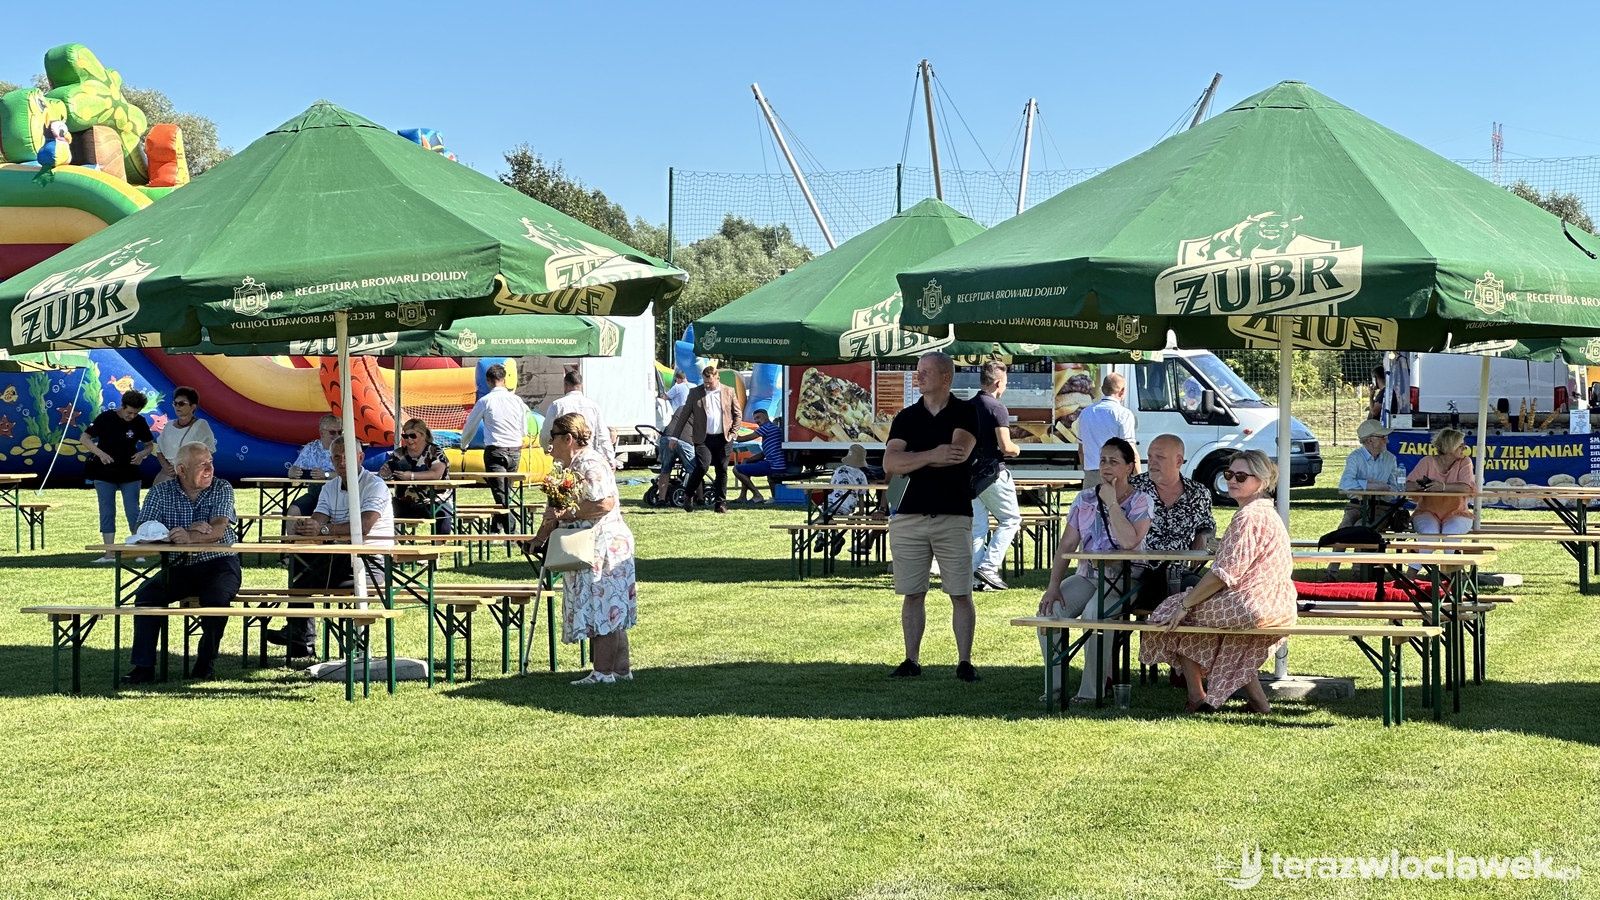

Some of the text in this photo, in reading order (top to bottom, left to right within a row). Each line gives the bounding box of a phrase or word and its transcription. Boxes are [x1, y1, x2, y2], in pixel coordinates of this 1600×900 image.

[270, 290, 284, 301] 68
[294, 281, 359, 298] RECEPTURA
[361, 273, 419, 289] BROWARU
[421, 270, 469, 283] DOJLIDY
[943, 294, 951, 304] 68
[957, 291, 995, 304] RECEPTURA
[995, 287, 1034, 300] BROWARU
[1034, 285, 1069, 298] DOJLIDY
[1463, 290, 1473, 300] 17
[1505, 291, 1517, 302] 68
[1526, 292, 1580, 306] RECEPTURA
[1581, 295, 1600, 307] BRO
[1500, 443, 1585, 459] ZIEMNIAK
